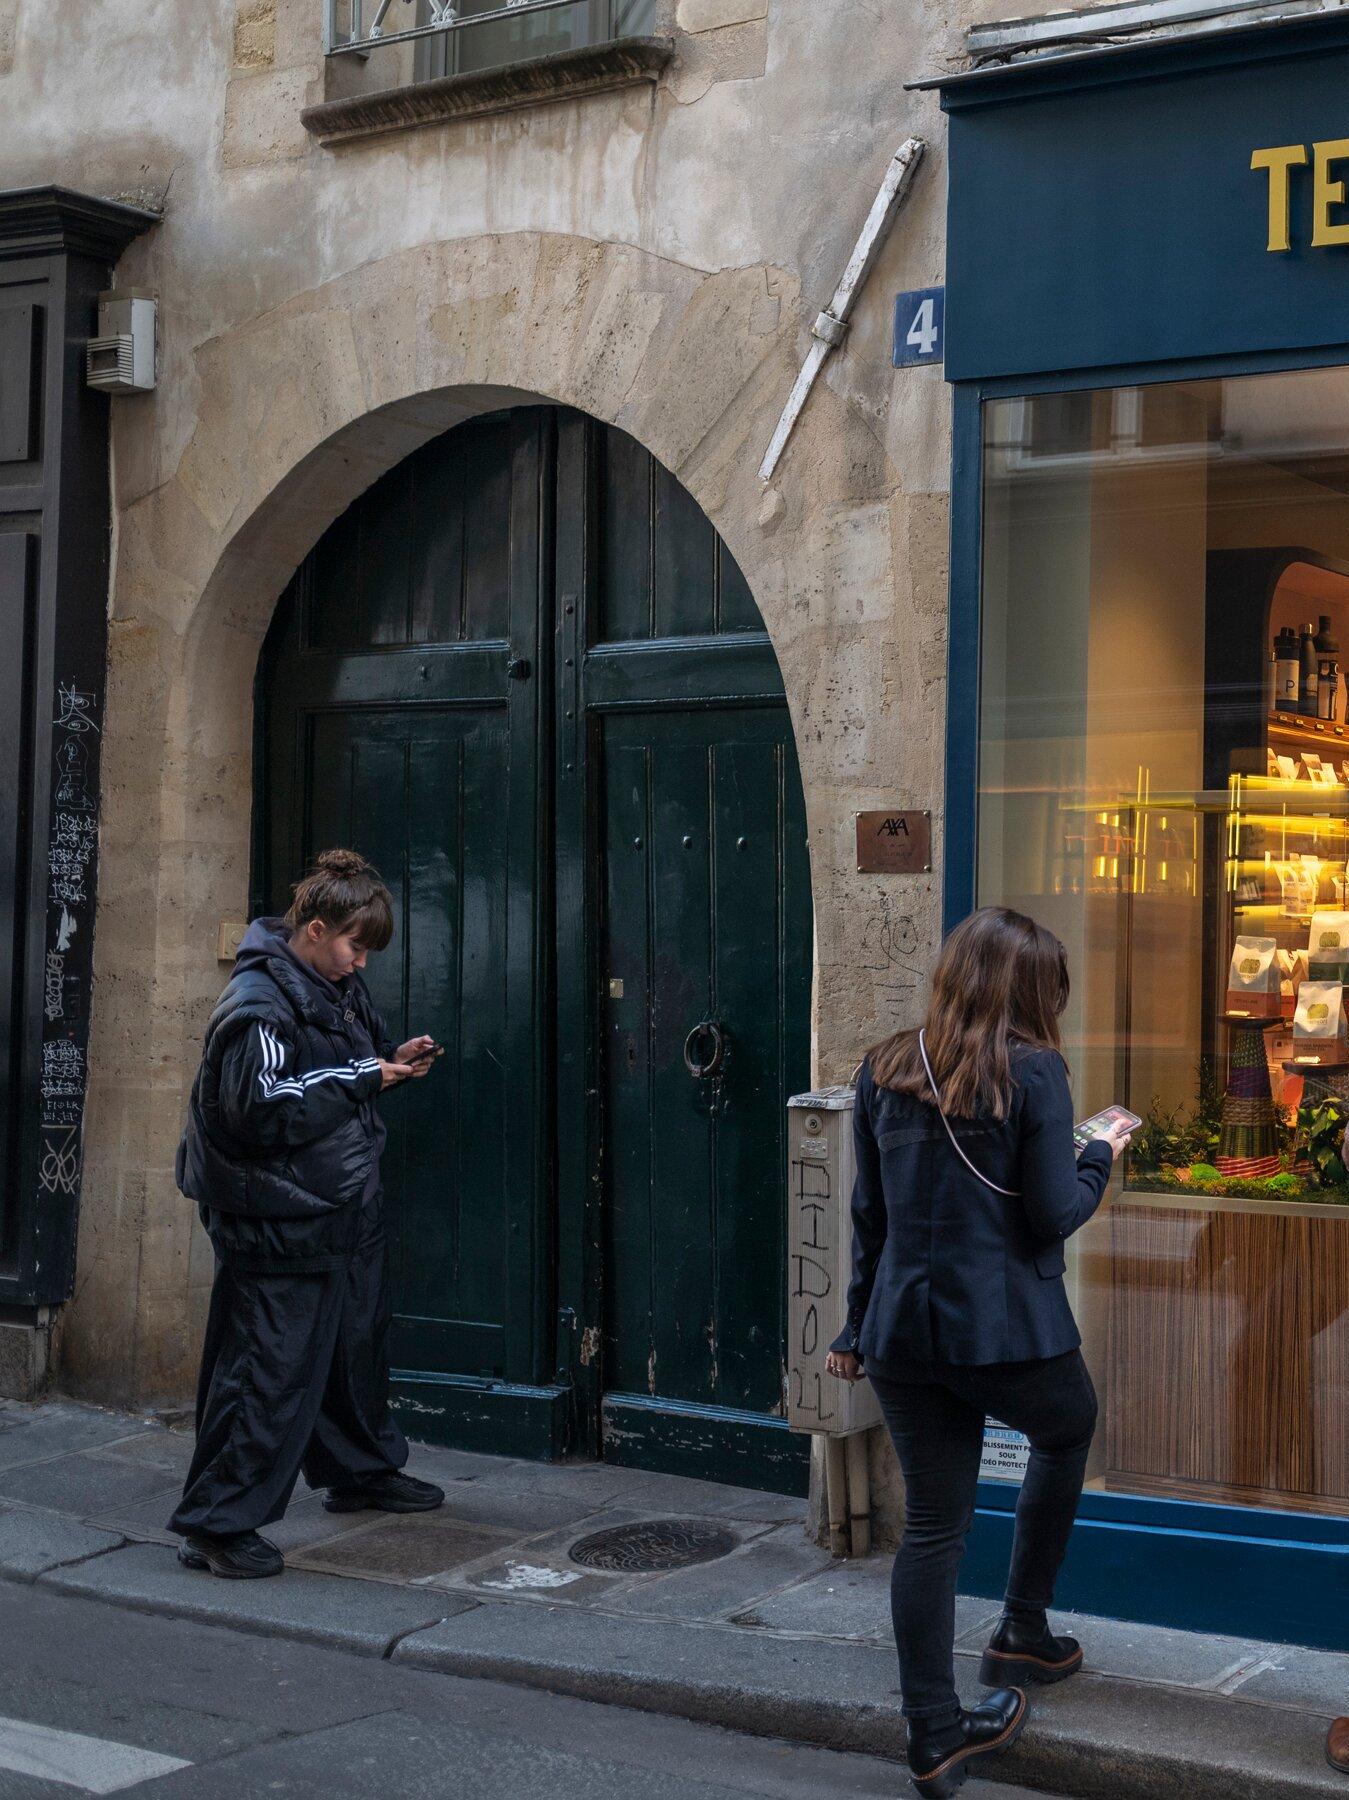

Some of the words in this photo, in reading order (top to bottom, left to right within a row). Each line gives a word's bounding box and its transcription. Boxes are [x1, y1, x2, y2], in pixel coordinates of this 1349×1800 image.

[907, 299, 938, 354] 4
[877, 818, 909, 836] AXA
[983, 1442, 1023, 1451] BLISSEMENT
[998, 1452, 1017, 1460] SOUS
[981, 1458, 997, 1466] IDÉO
[997, 1460, 1028, 1469] PROTECT
